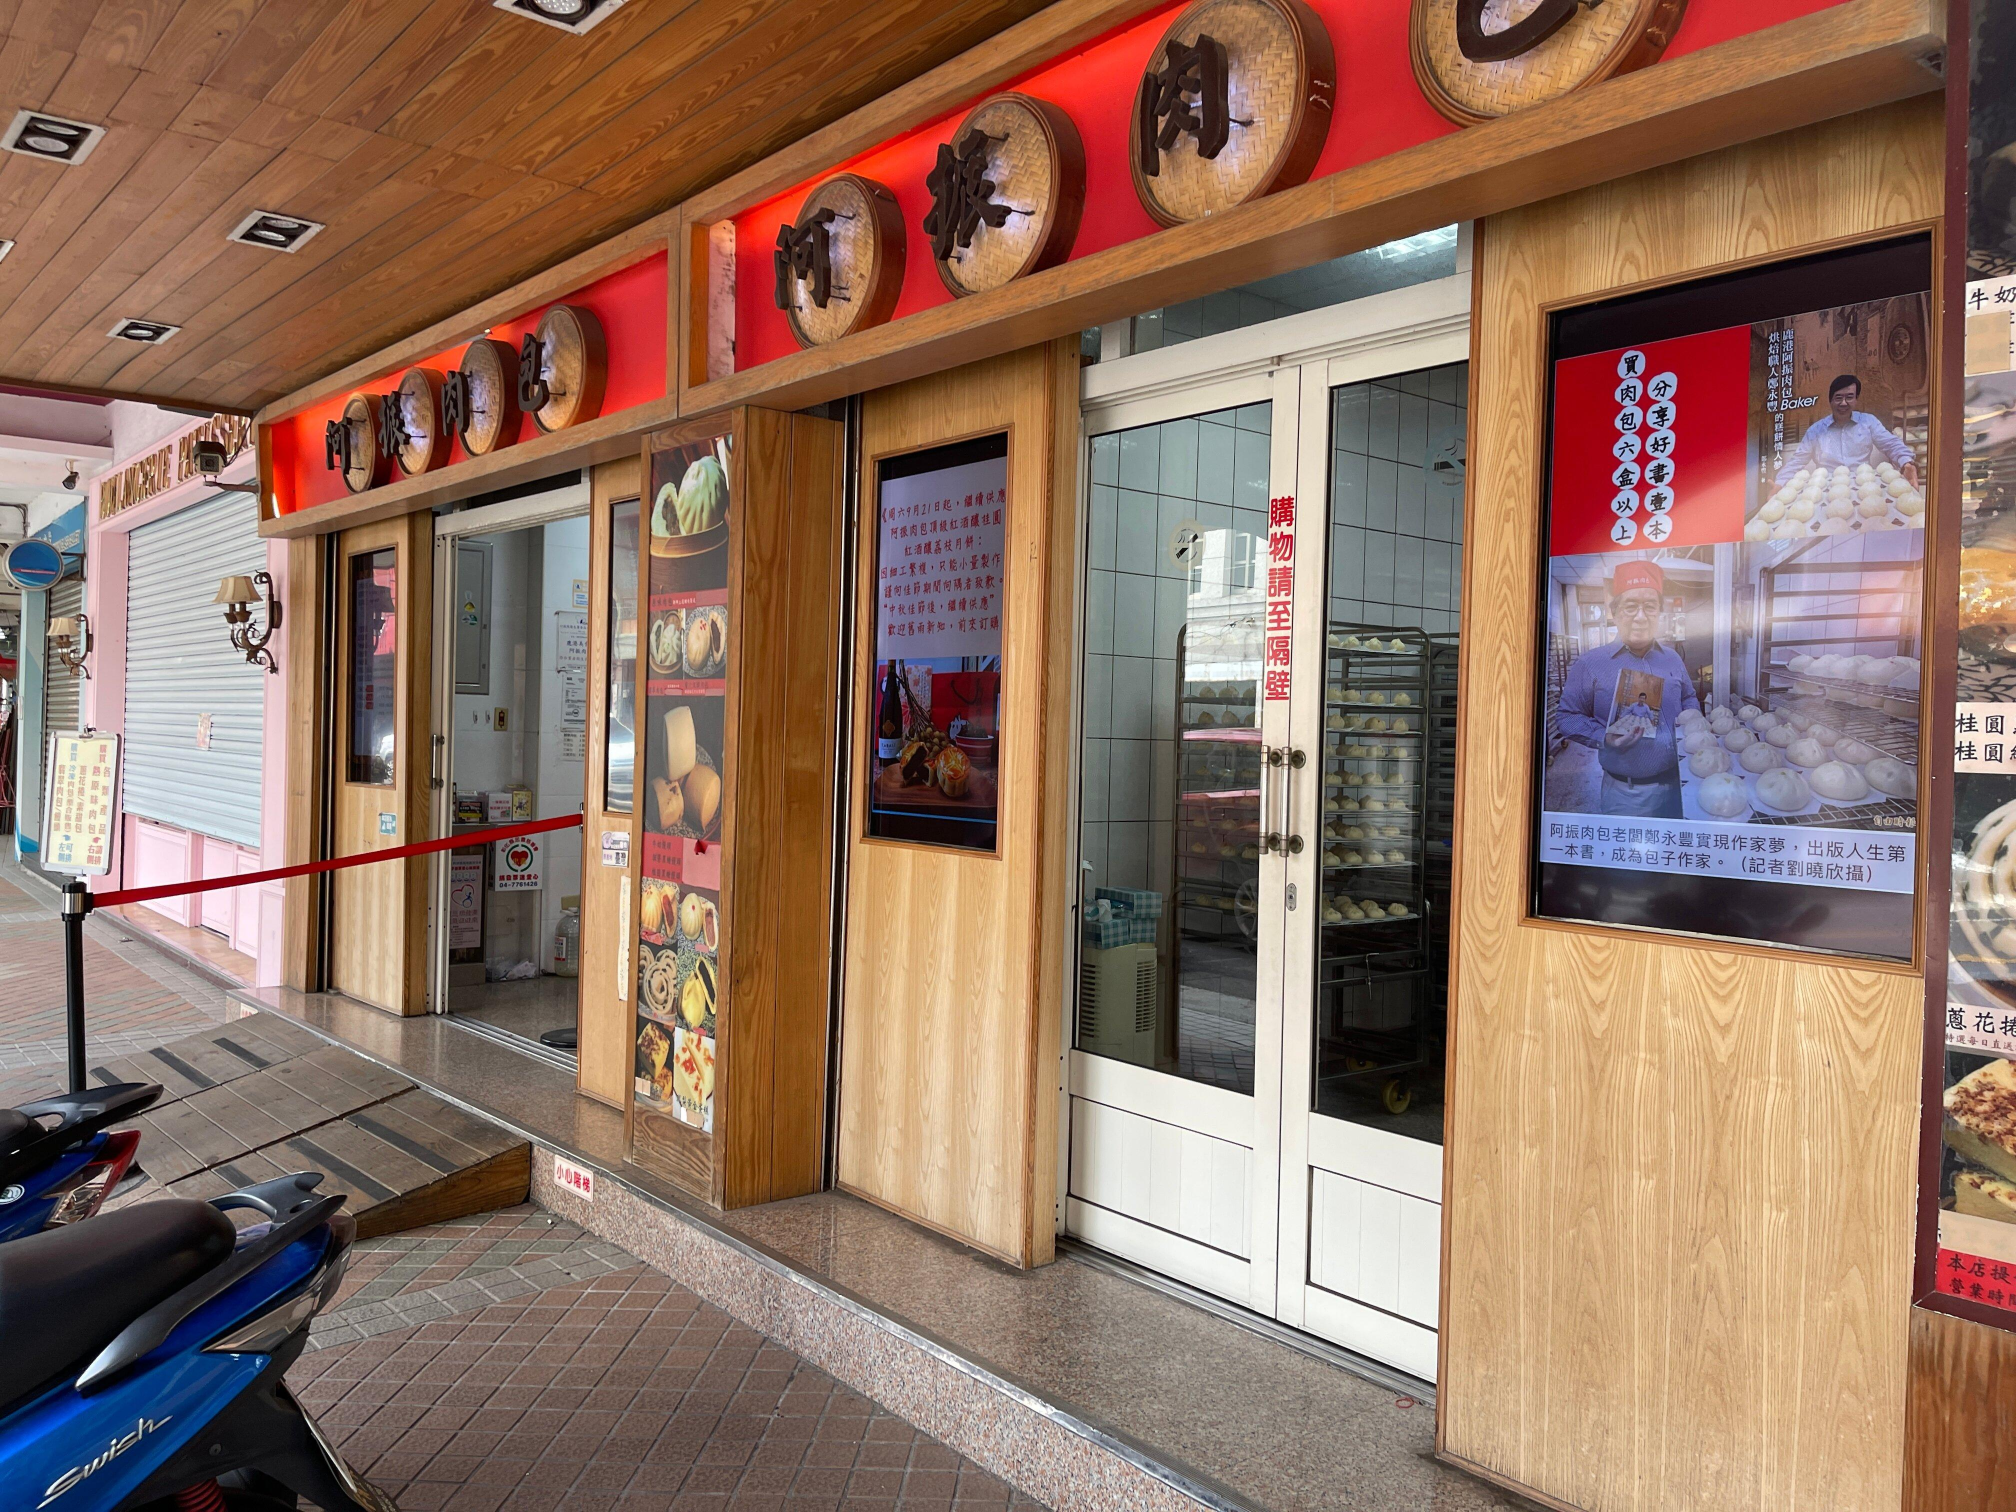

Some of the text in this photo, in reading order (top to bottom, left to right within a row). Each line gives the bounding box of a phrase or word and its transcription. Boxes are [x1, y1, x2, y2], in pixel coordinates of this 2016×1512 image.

[1968, 286, 2016, 310] 牛奶
[1781, 328, 1794, 399] 鹿港阿振肉包
[325, 333, 550, 475] 阿振肉包
[1780, 396, 1818, 411] Baker
[1615, 354, 1640, 542] 買肉包六盒以上
[1647, 379, 1672, 540] 分享好書壹本
[1773, 412, 1784, 471] 的糕餅情人夢
[890, 508, 1001, 540] 阿振肉包頂級紅酒釀桂圓
[1265, 496, 1295, 701] 購物請至隔壁
[1550, 823, 1906, 863] 阿振肉包老闆鄭永豐實現作家夢，出版人生第
[1945, 1032, 2016, 1052] 特選每日直送
[556, 1164, 591, 1193] 小心階梯
[1947, 1253, 2016, 1285] 本店提
[36, 1415, 173, 1510] Swish
